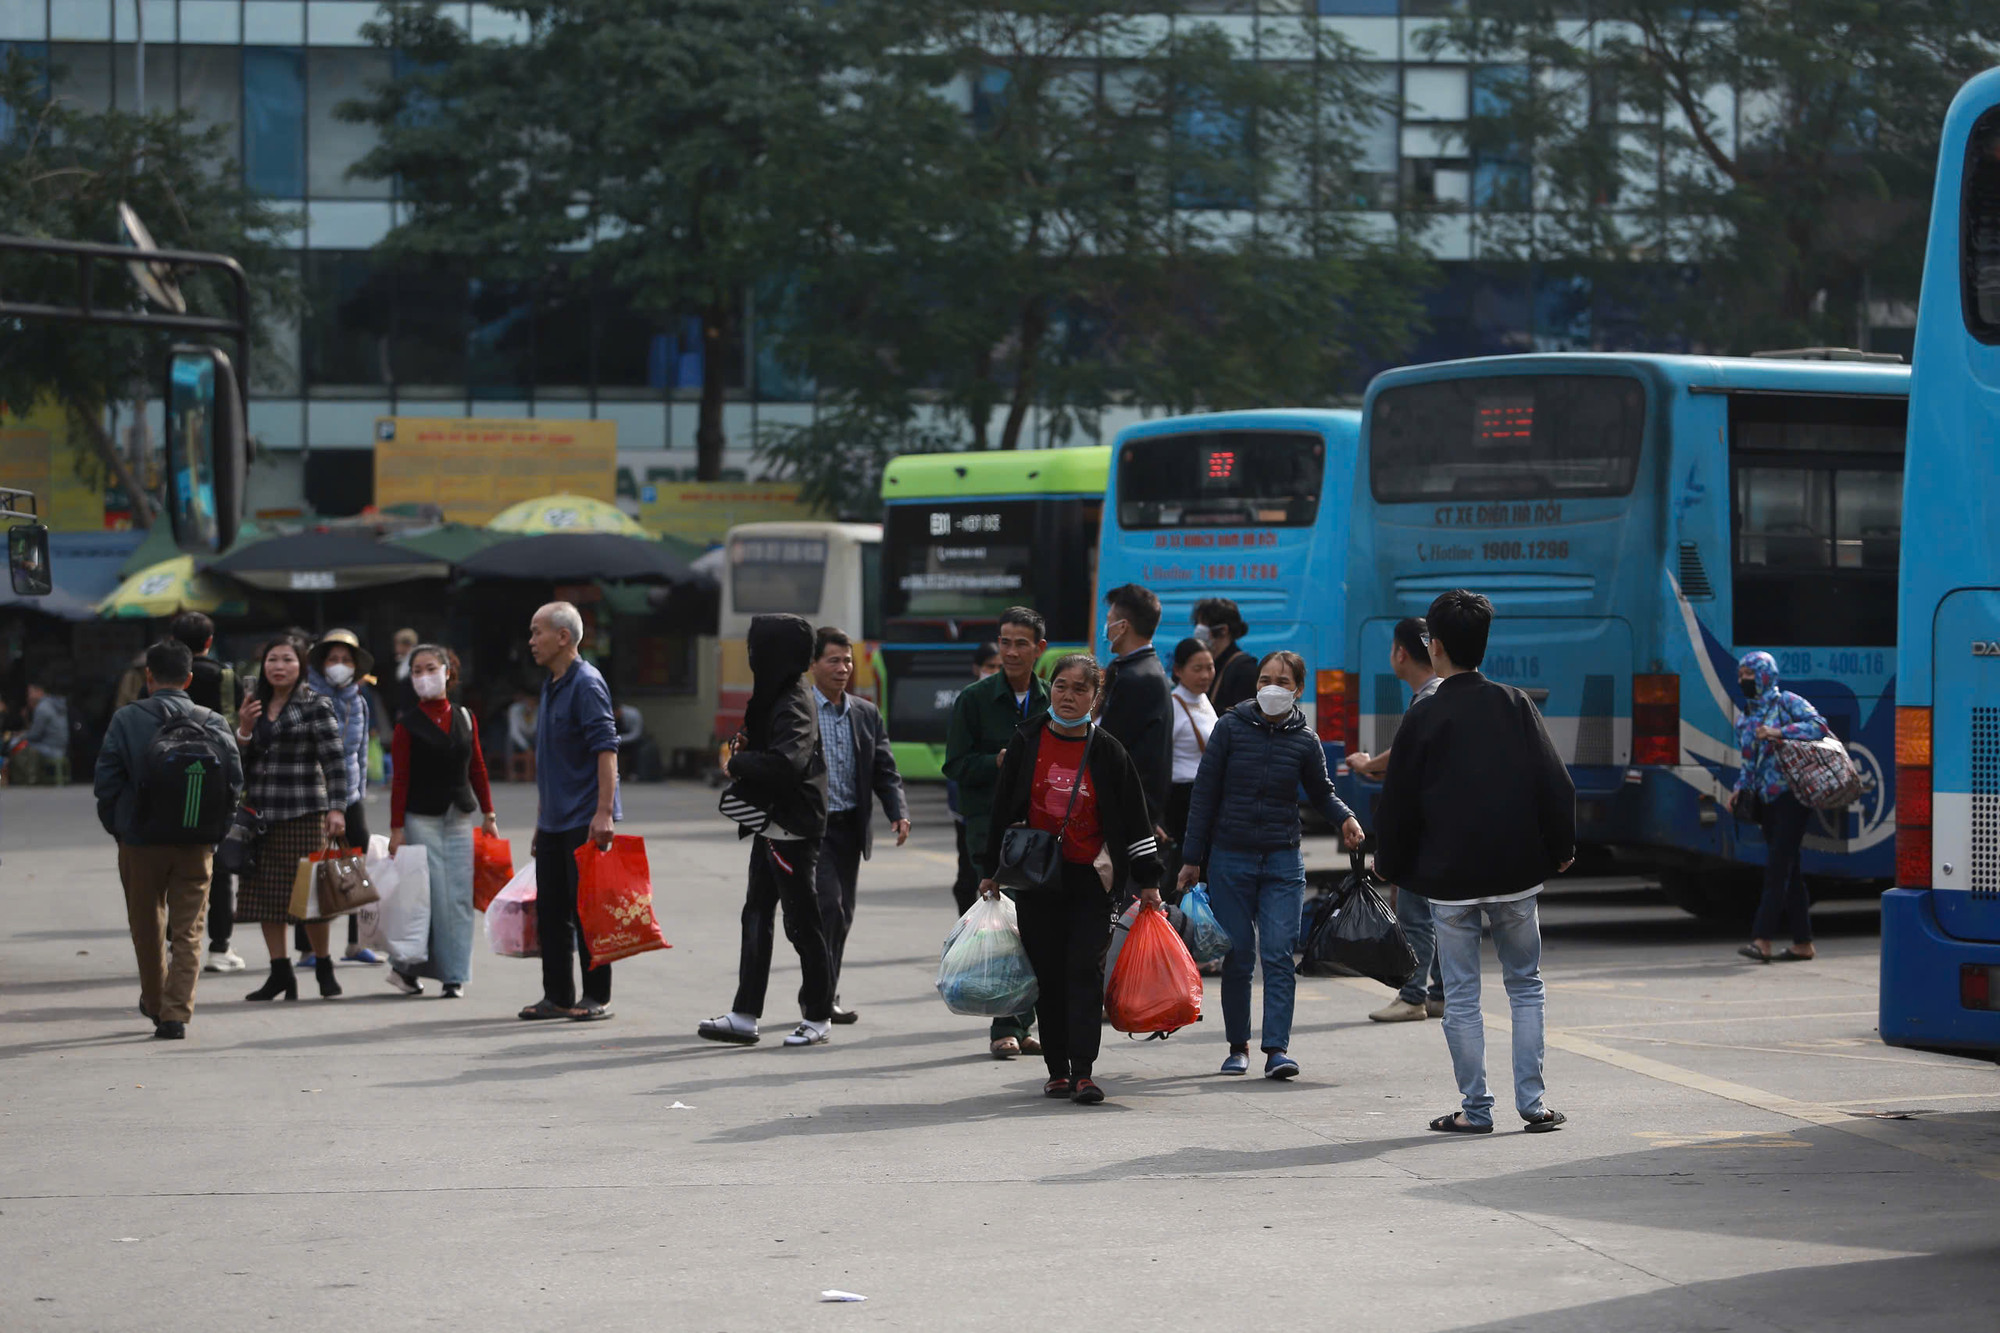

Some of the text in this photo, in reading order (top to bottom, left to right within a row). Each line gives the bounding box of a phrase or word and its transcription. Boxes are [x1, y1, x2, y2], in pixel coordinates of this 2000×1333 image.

[1435, 507, 1453, 524] CT
[1456, 506, 1473, 524] XE
[1431, 543, 1474, 561] Hotline
[1971, 641, 2000, 655] DA
[1780, 652, 1811, 675] 29B
[1829, 652, 1884, 675] 400.16
